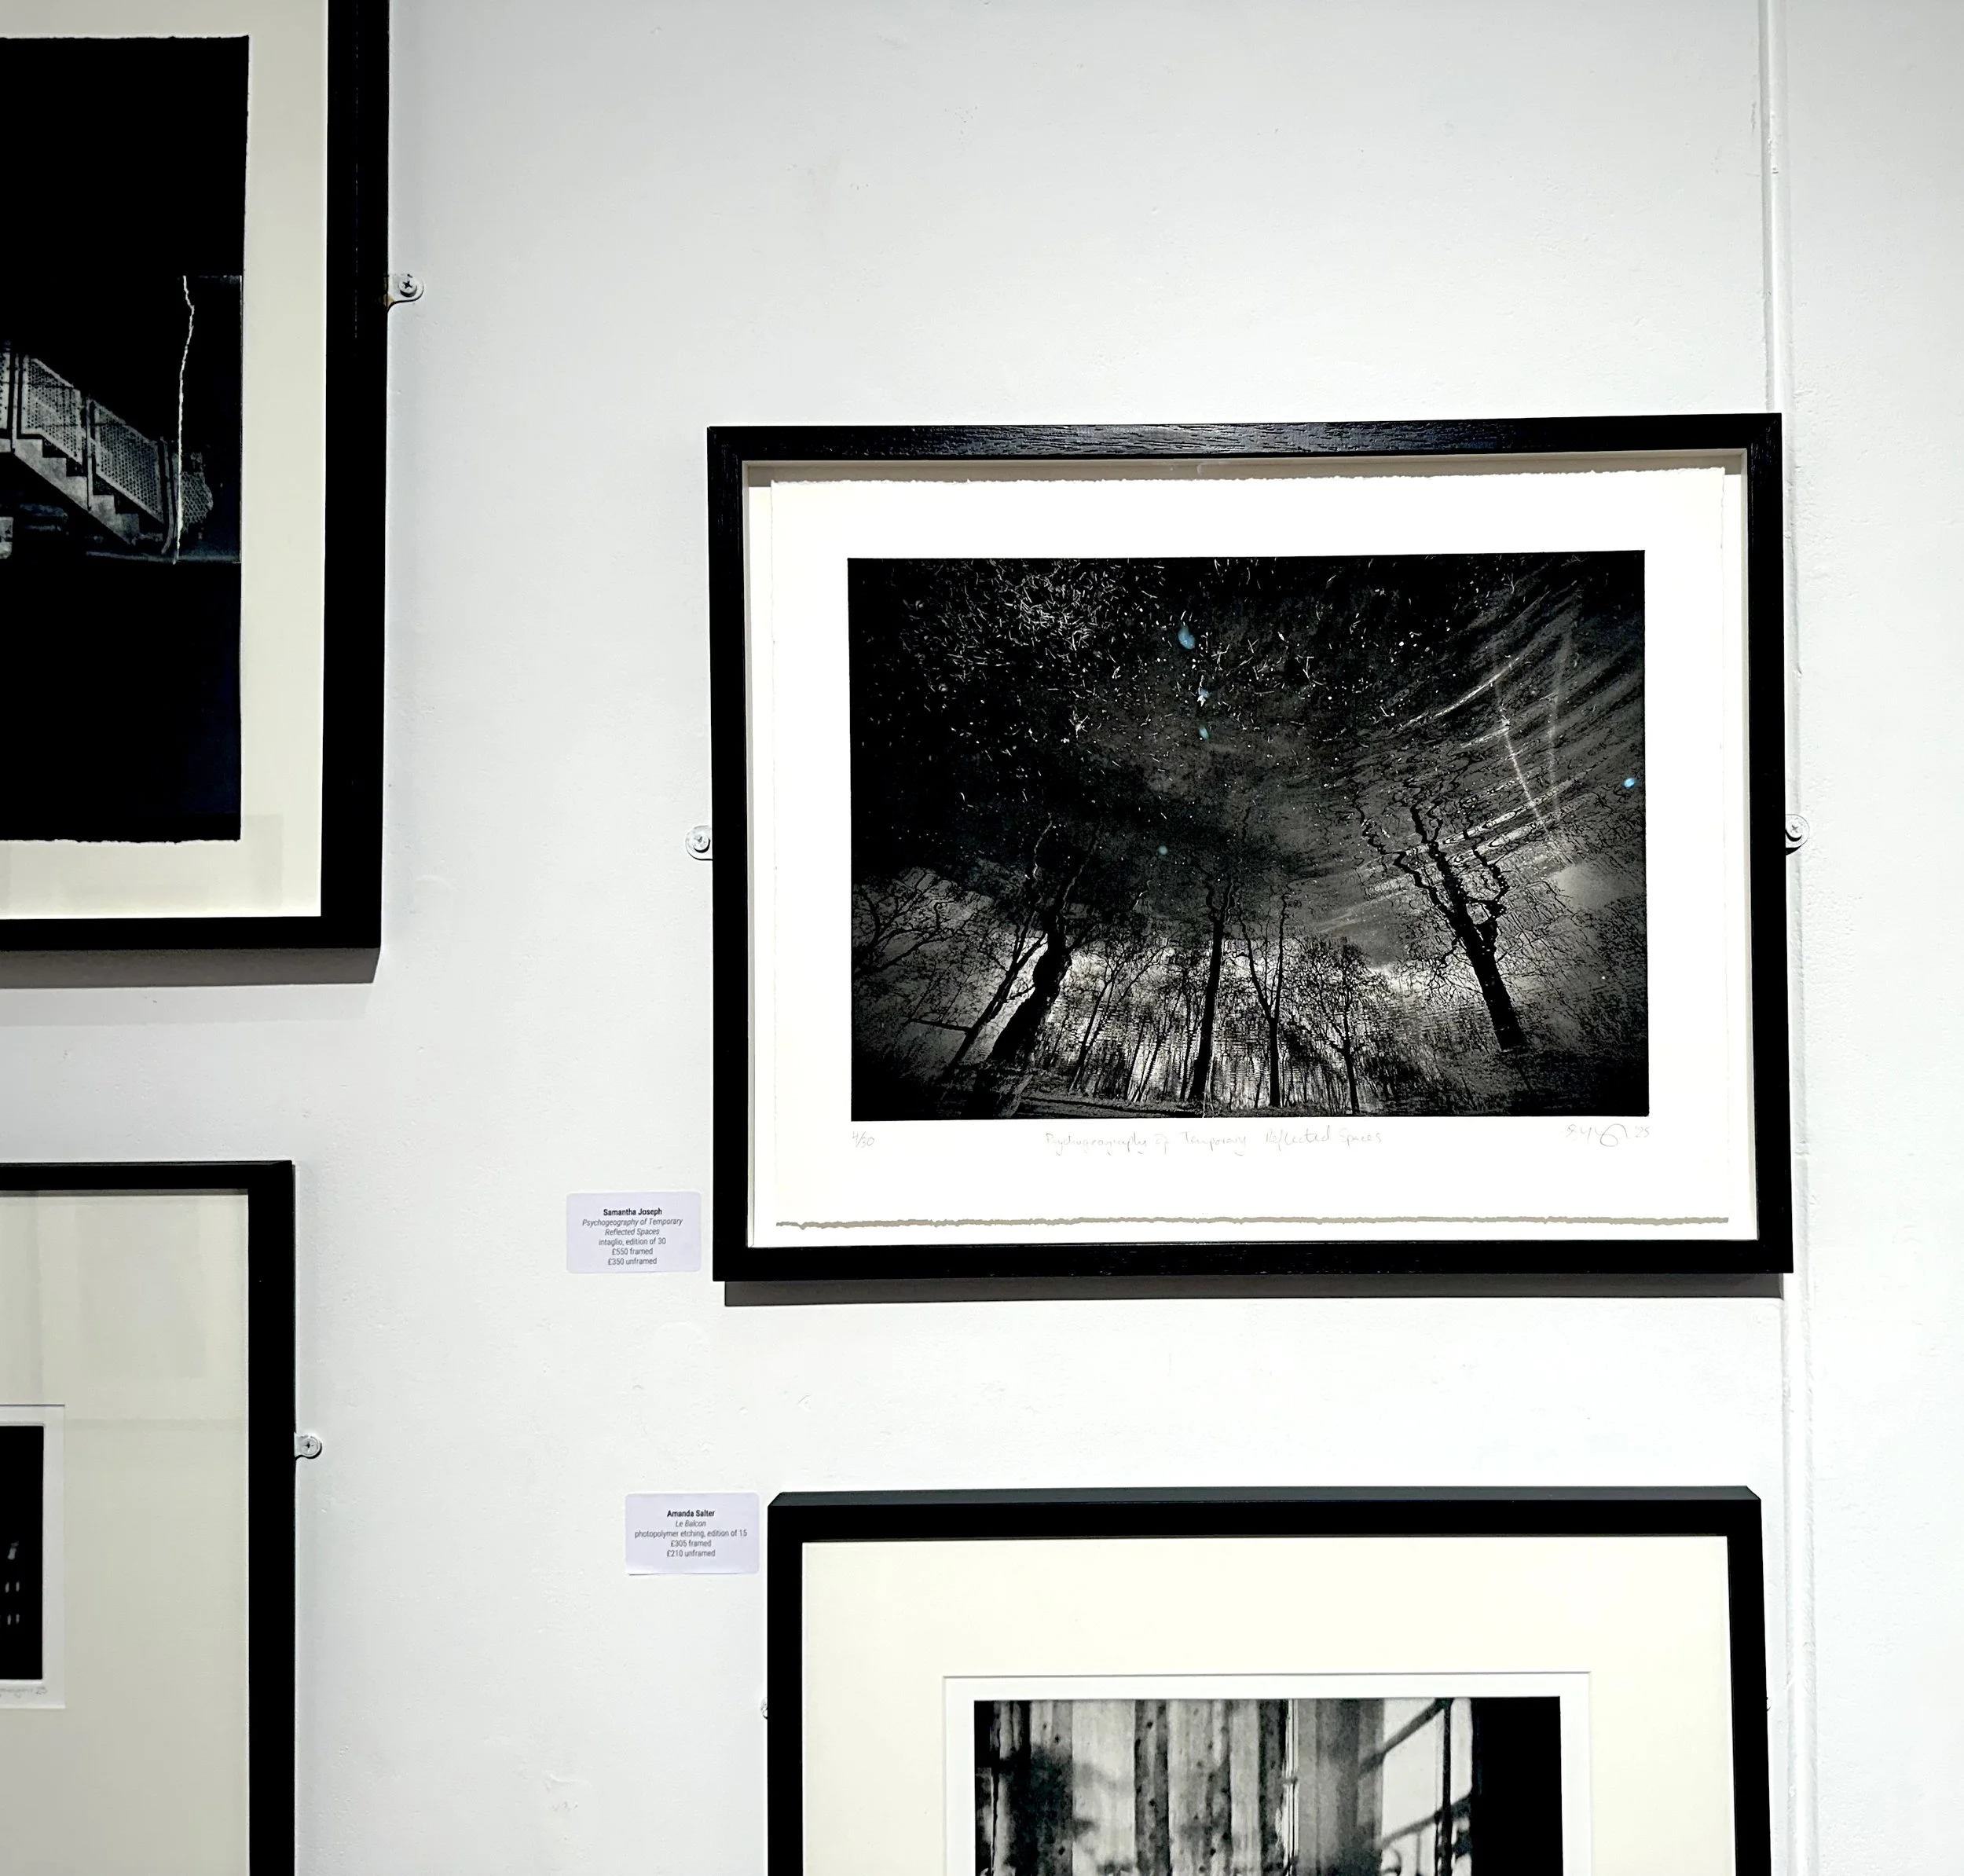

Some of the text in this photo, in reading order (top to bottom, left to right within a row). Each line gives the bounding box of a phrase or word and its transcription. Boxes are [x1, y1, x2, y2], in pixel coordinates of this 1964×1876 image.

[638, 1207, 662, 1217] Joseph
[582, 1218, 639, 1227] Psychogeography
[649, 1218, 683, 1226] Temporary
[636, 1228, 660, 1237] Spaces
[635, 1530, 679, 1539] photopolymer
